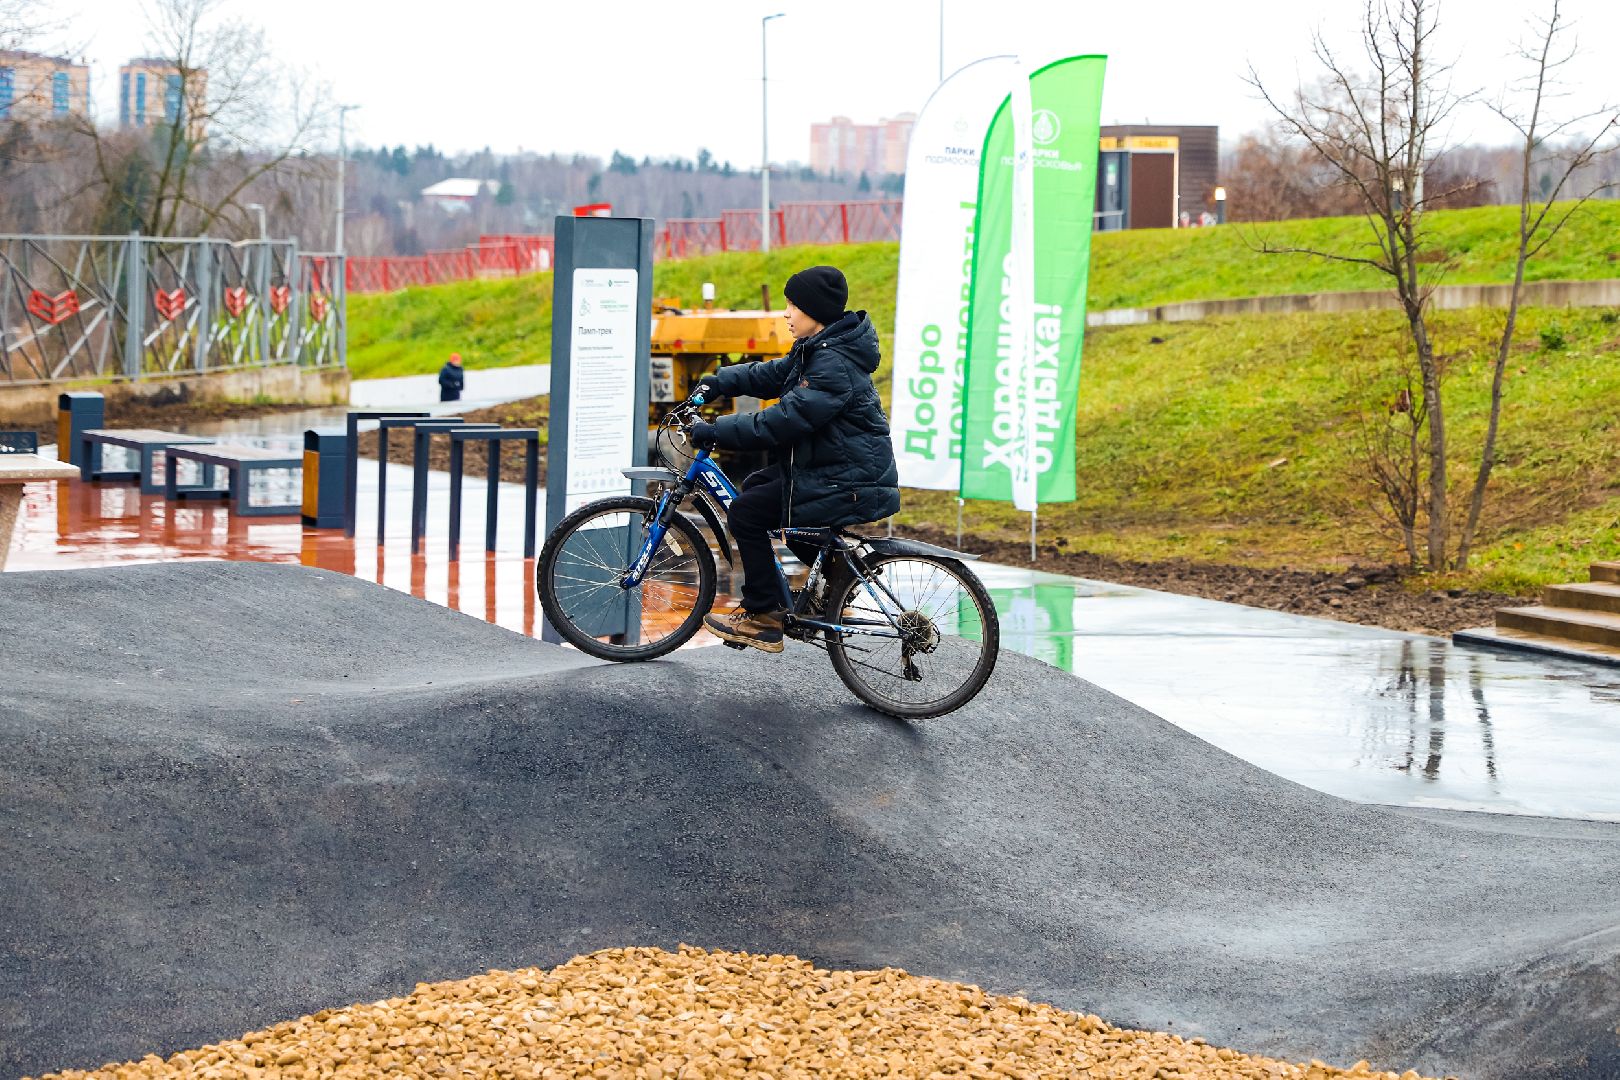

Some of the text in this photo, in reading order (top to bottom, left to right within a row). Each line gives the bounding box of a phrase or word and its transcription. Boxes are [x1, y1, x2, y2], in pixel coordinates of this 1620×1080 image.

[945, 146, 975, 156] ПАРКИ
[1032, 148, 1059, 159] АРКИ
[578, 326, 613, 336] Памп-трек
[904, 324, 944, 460] Добро
